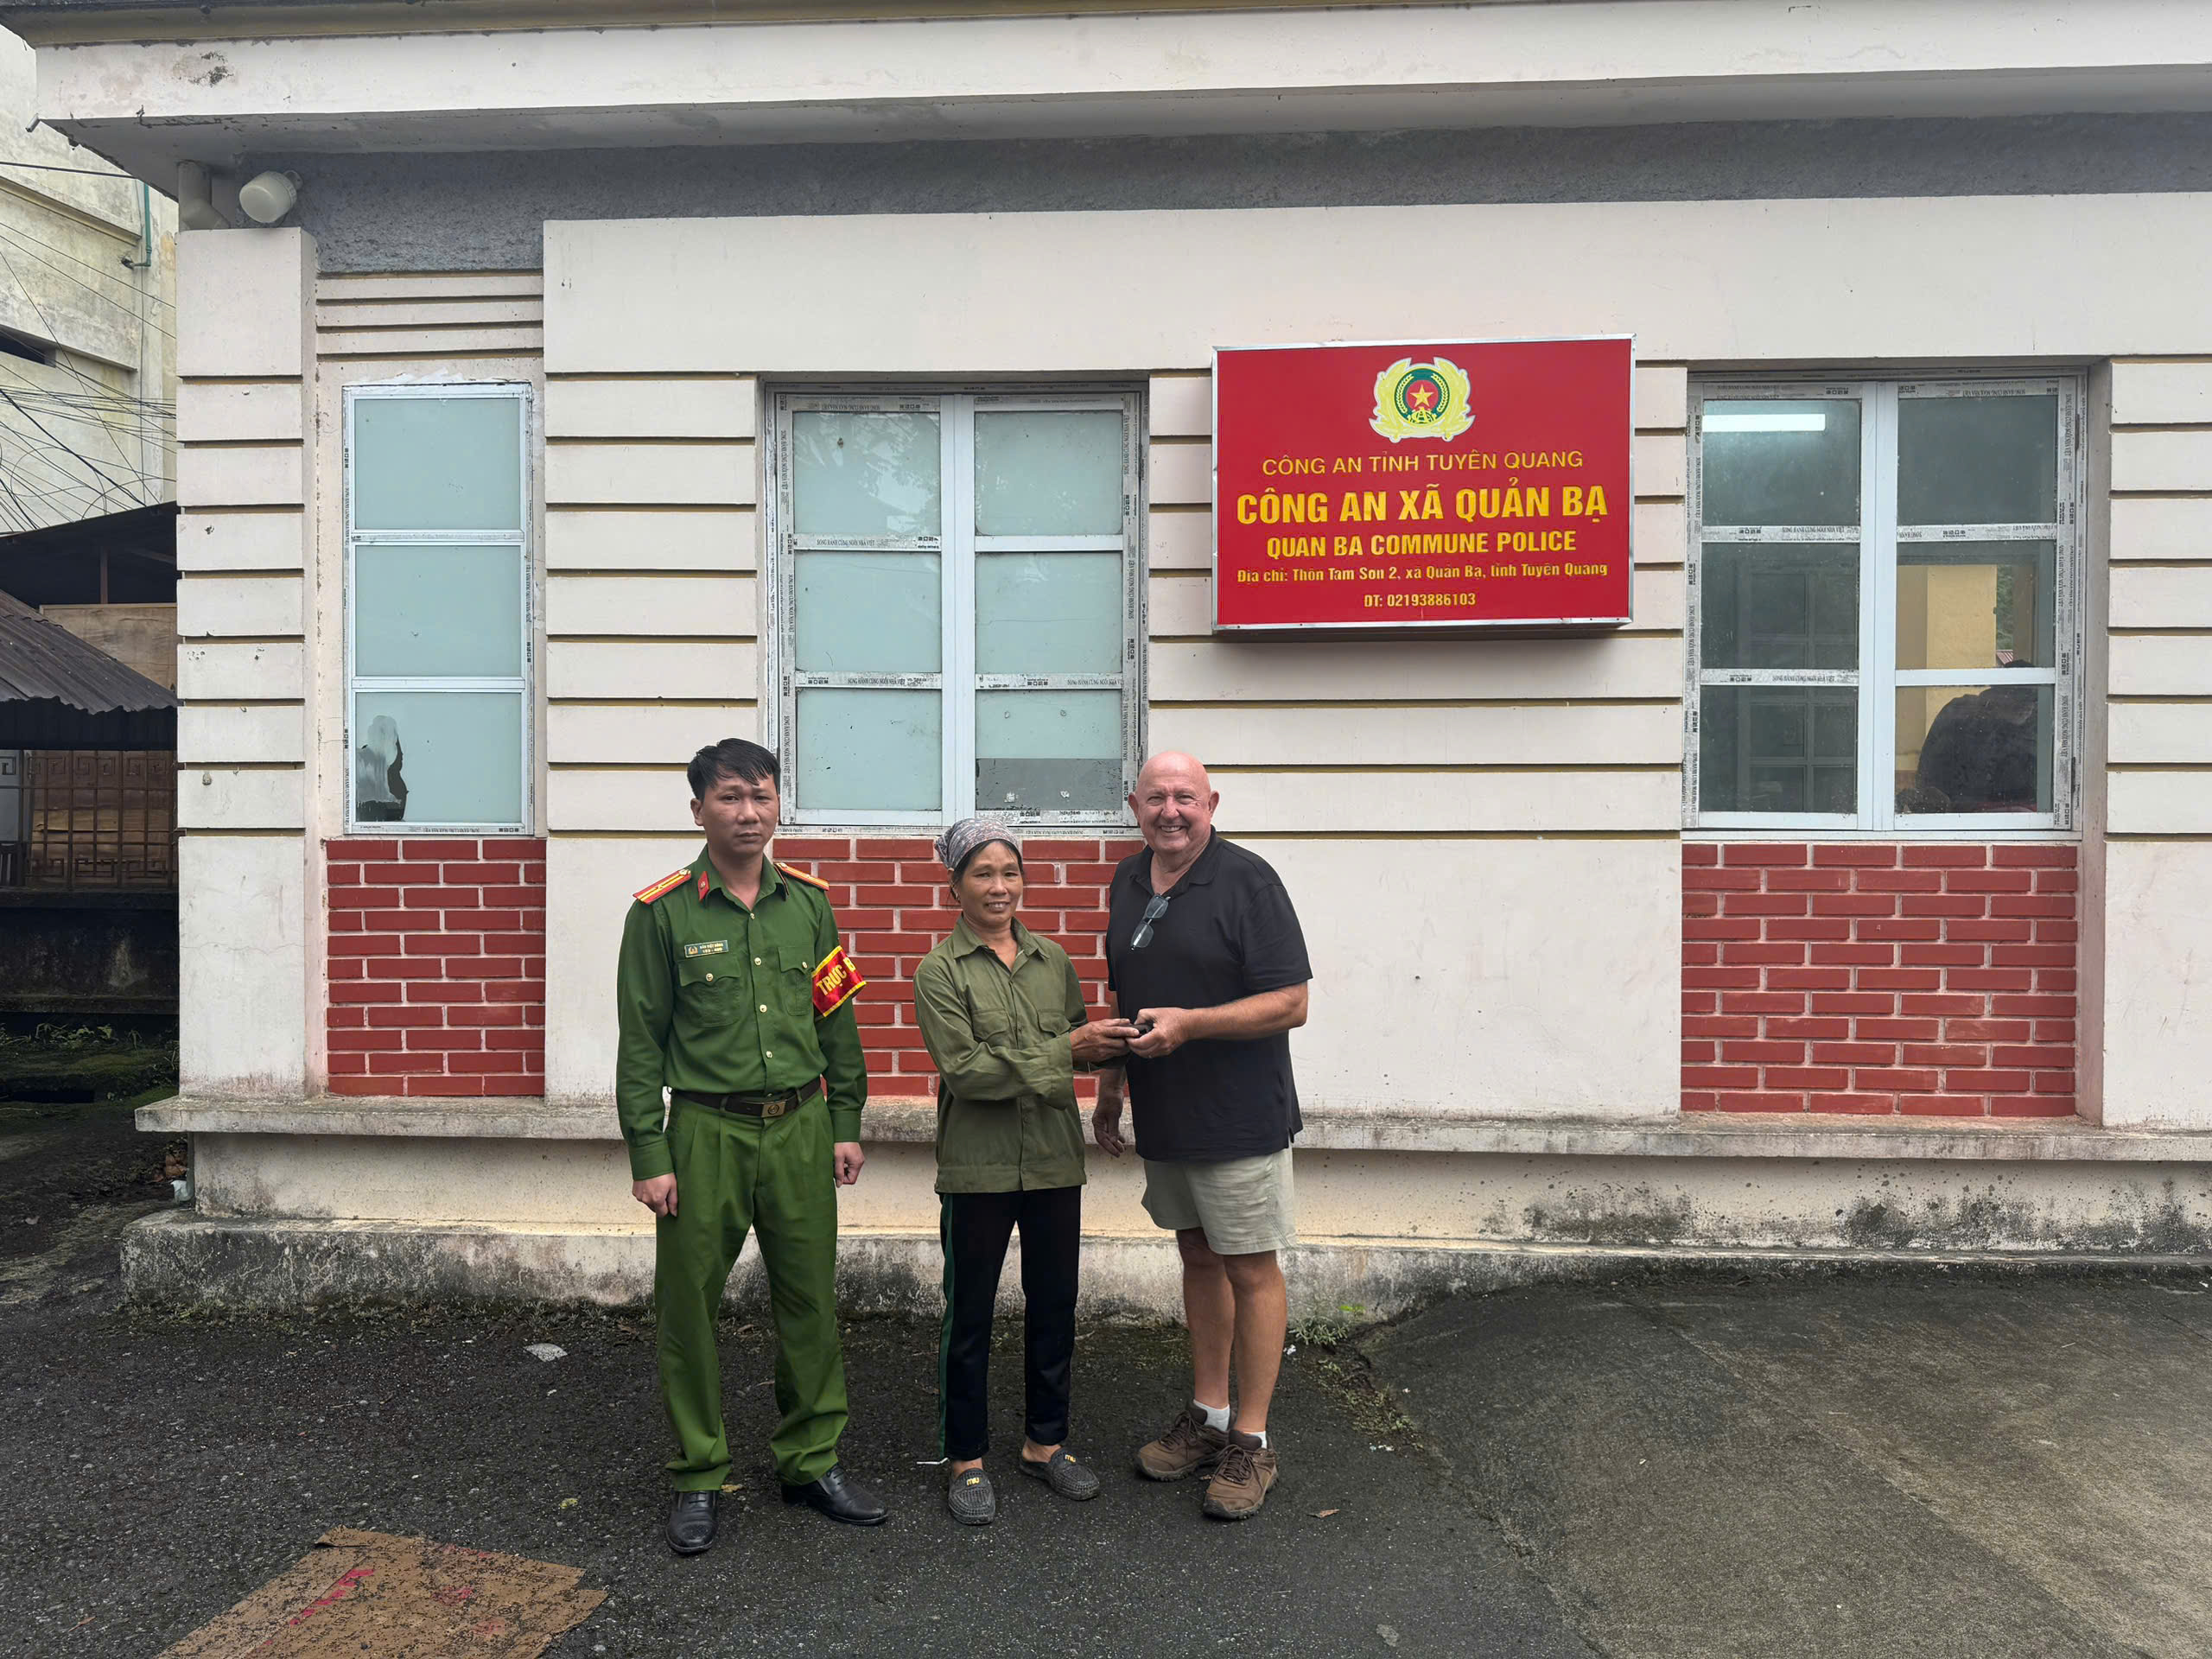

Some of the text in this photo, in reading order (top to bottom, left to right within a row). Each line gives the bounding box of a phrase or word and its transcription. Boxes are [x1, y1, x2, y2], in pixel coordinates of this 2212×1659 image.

[1262, 449, 1583, 476] CÔNG AN TỈNH TUYÊN QUANG
[1236, 476, 1608, 524] CÔNG AN XÃ QUẢN BẠ
[1267, 531, 1577, 560] QUAN BA COMMUNE POLICE
[1293, 569, 1324, 582] Thôn
[1328, 567, 1355, 581] Tam
[1389, 566, 1402, 580] 2,
[1405, 566, 1422, 579] xã
[1426, 563, 1460, 580] Quản
[1465, 564, 1487, 581] Bạ,
[1521, 563, 1560, 578] Tuyên
[1564, 563, 1609, 577] Quang
[1387, 593, 1476, 607] 02193886103
[816, 964, 848, 996] TRỰC
